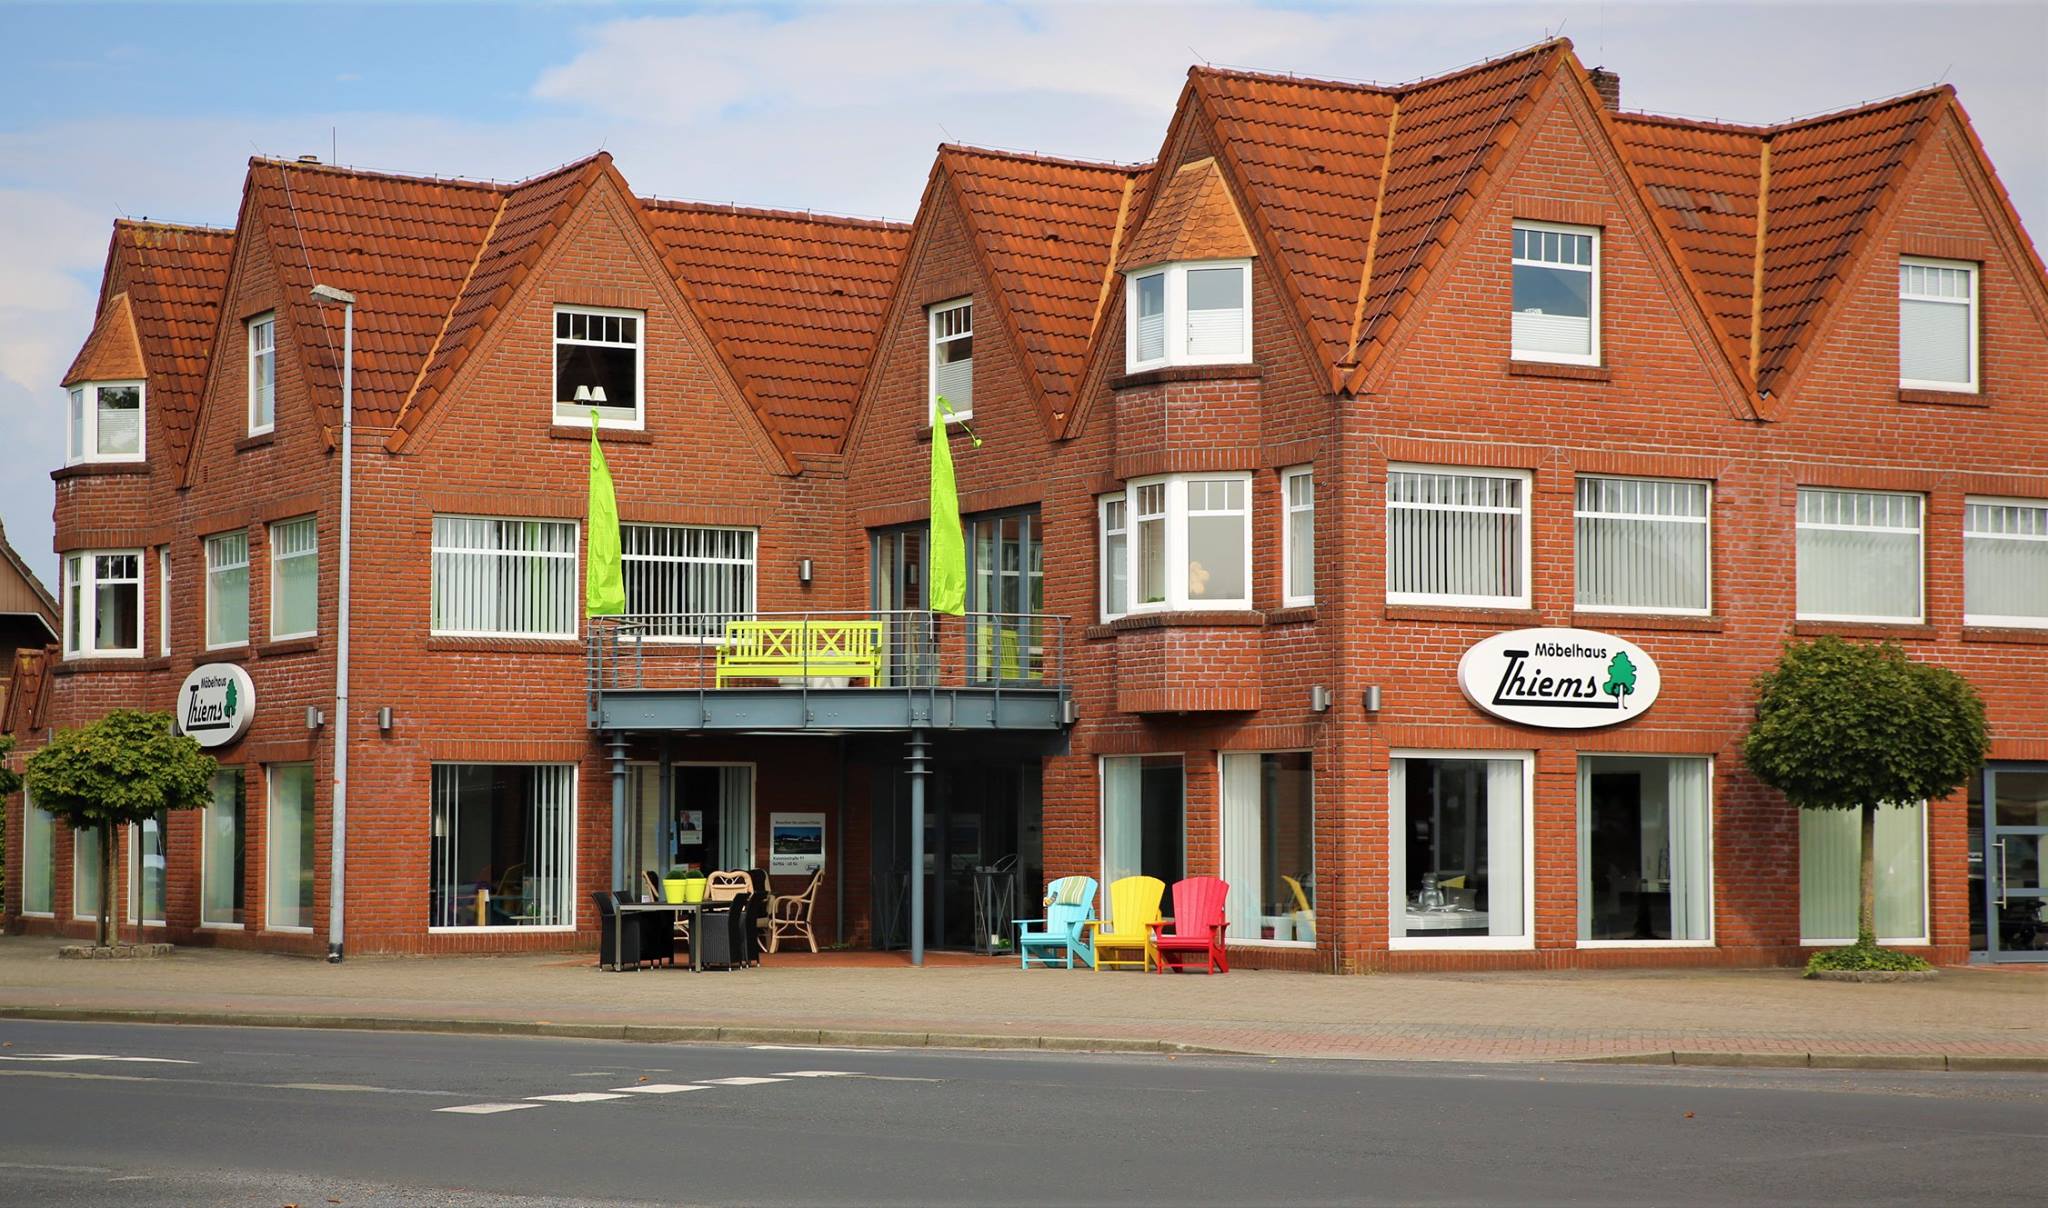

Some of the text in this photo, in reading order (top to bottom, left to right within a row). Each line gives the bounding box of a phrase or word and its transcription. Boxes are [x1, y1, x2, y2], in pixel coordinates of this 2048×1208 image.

[1534, 642, 1607, 659] Möbelhaus
[200, 676, 227, 689] Möbelhaus
[1491, 649, 1599, 707] Thiems
[186, 684, 223, 731] Thiems
